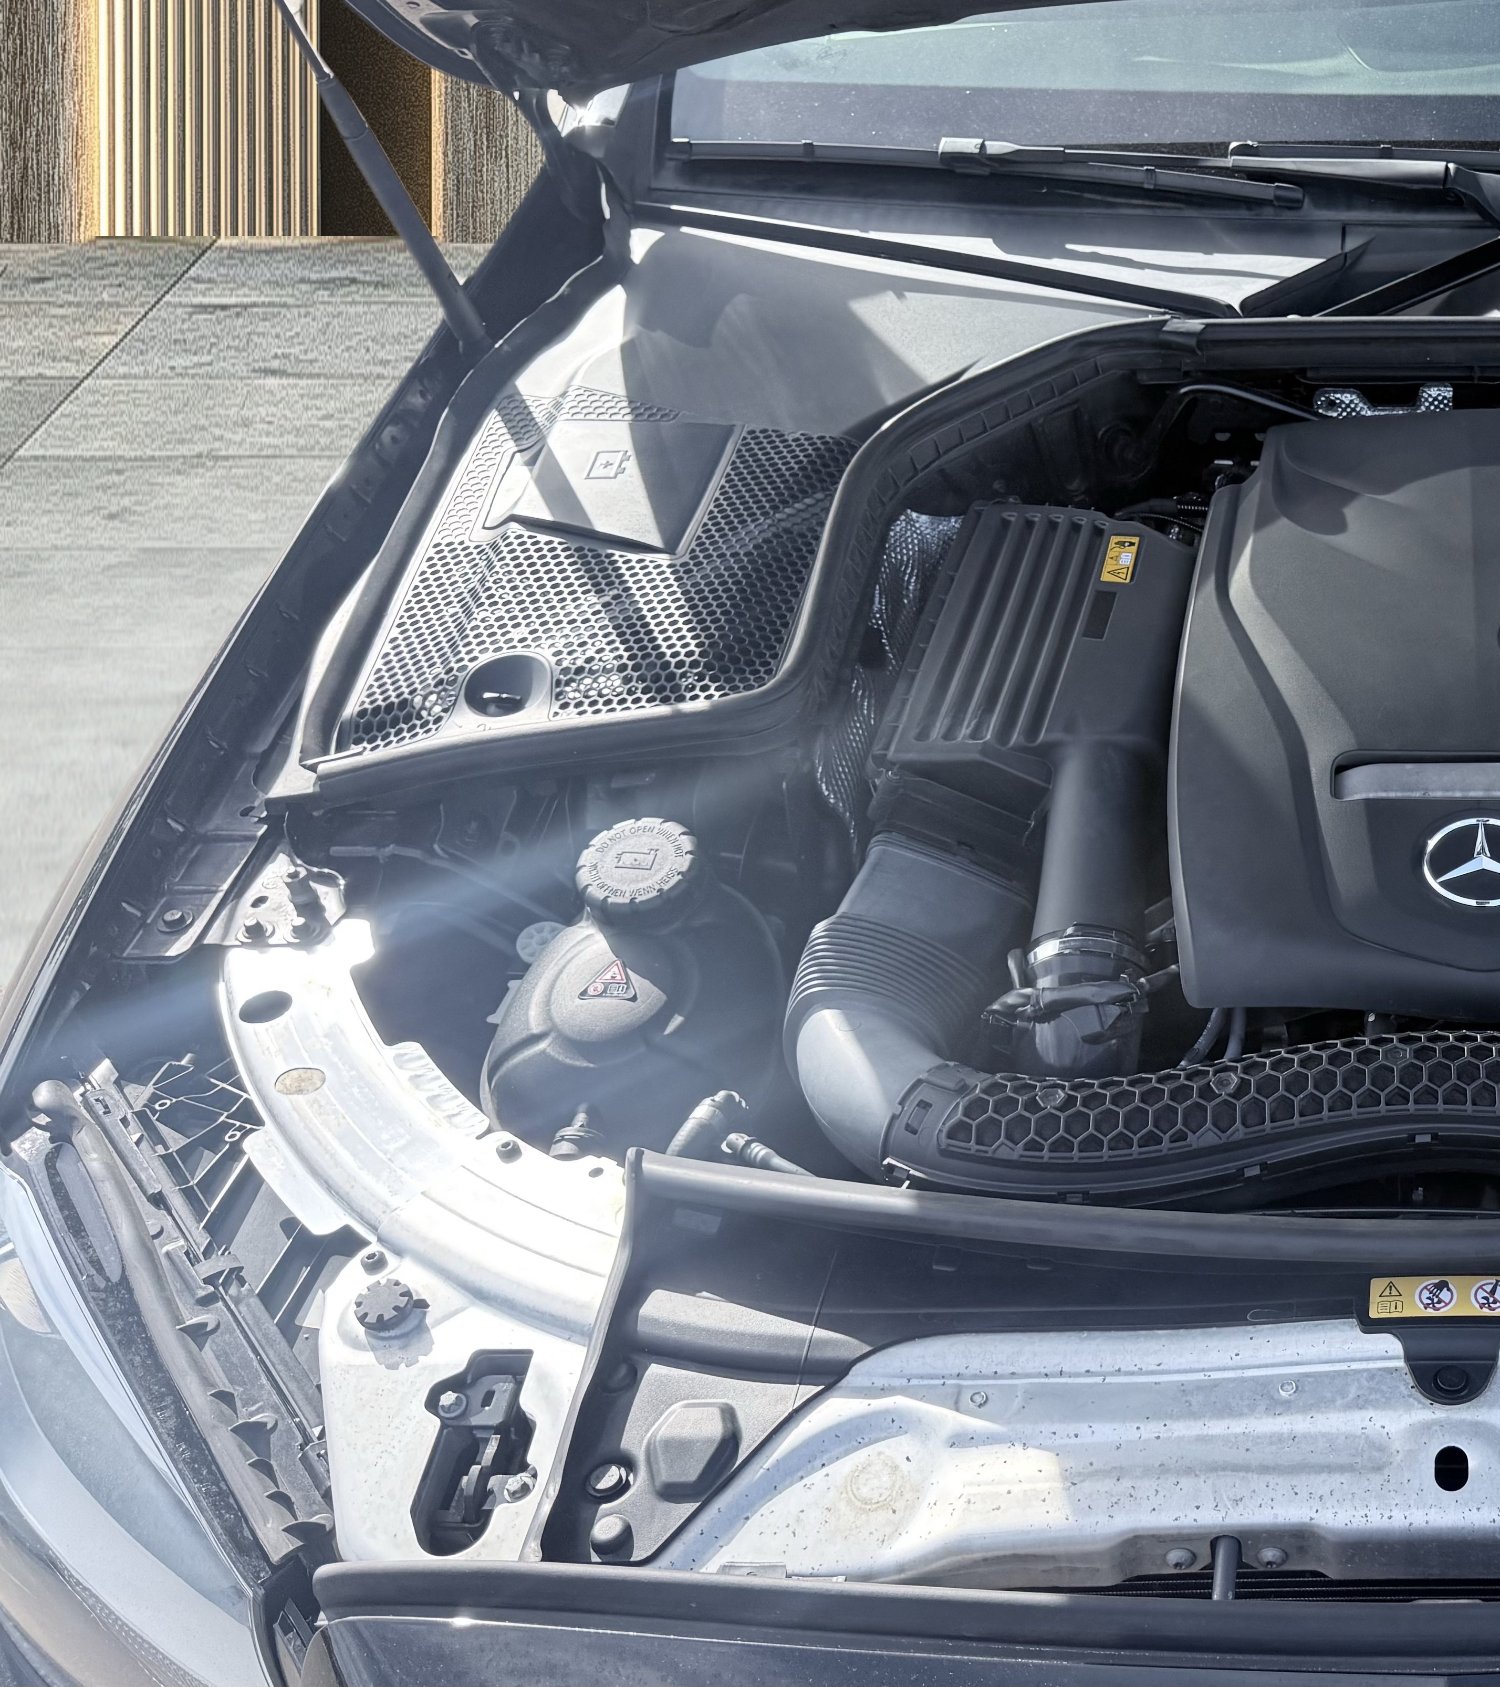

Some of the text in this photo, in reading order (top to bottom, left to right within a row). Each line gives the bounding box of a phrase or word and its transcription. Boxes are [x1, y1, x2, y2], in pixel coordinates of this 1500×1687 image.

[595, 825, 684, 858] DO NOT OPEN WHEN HOT
[588, 861, 602, 883] NICHT
[629, 883, 656, 898] WENN
[656, 867, 679, 887] HEISS
